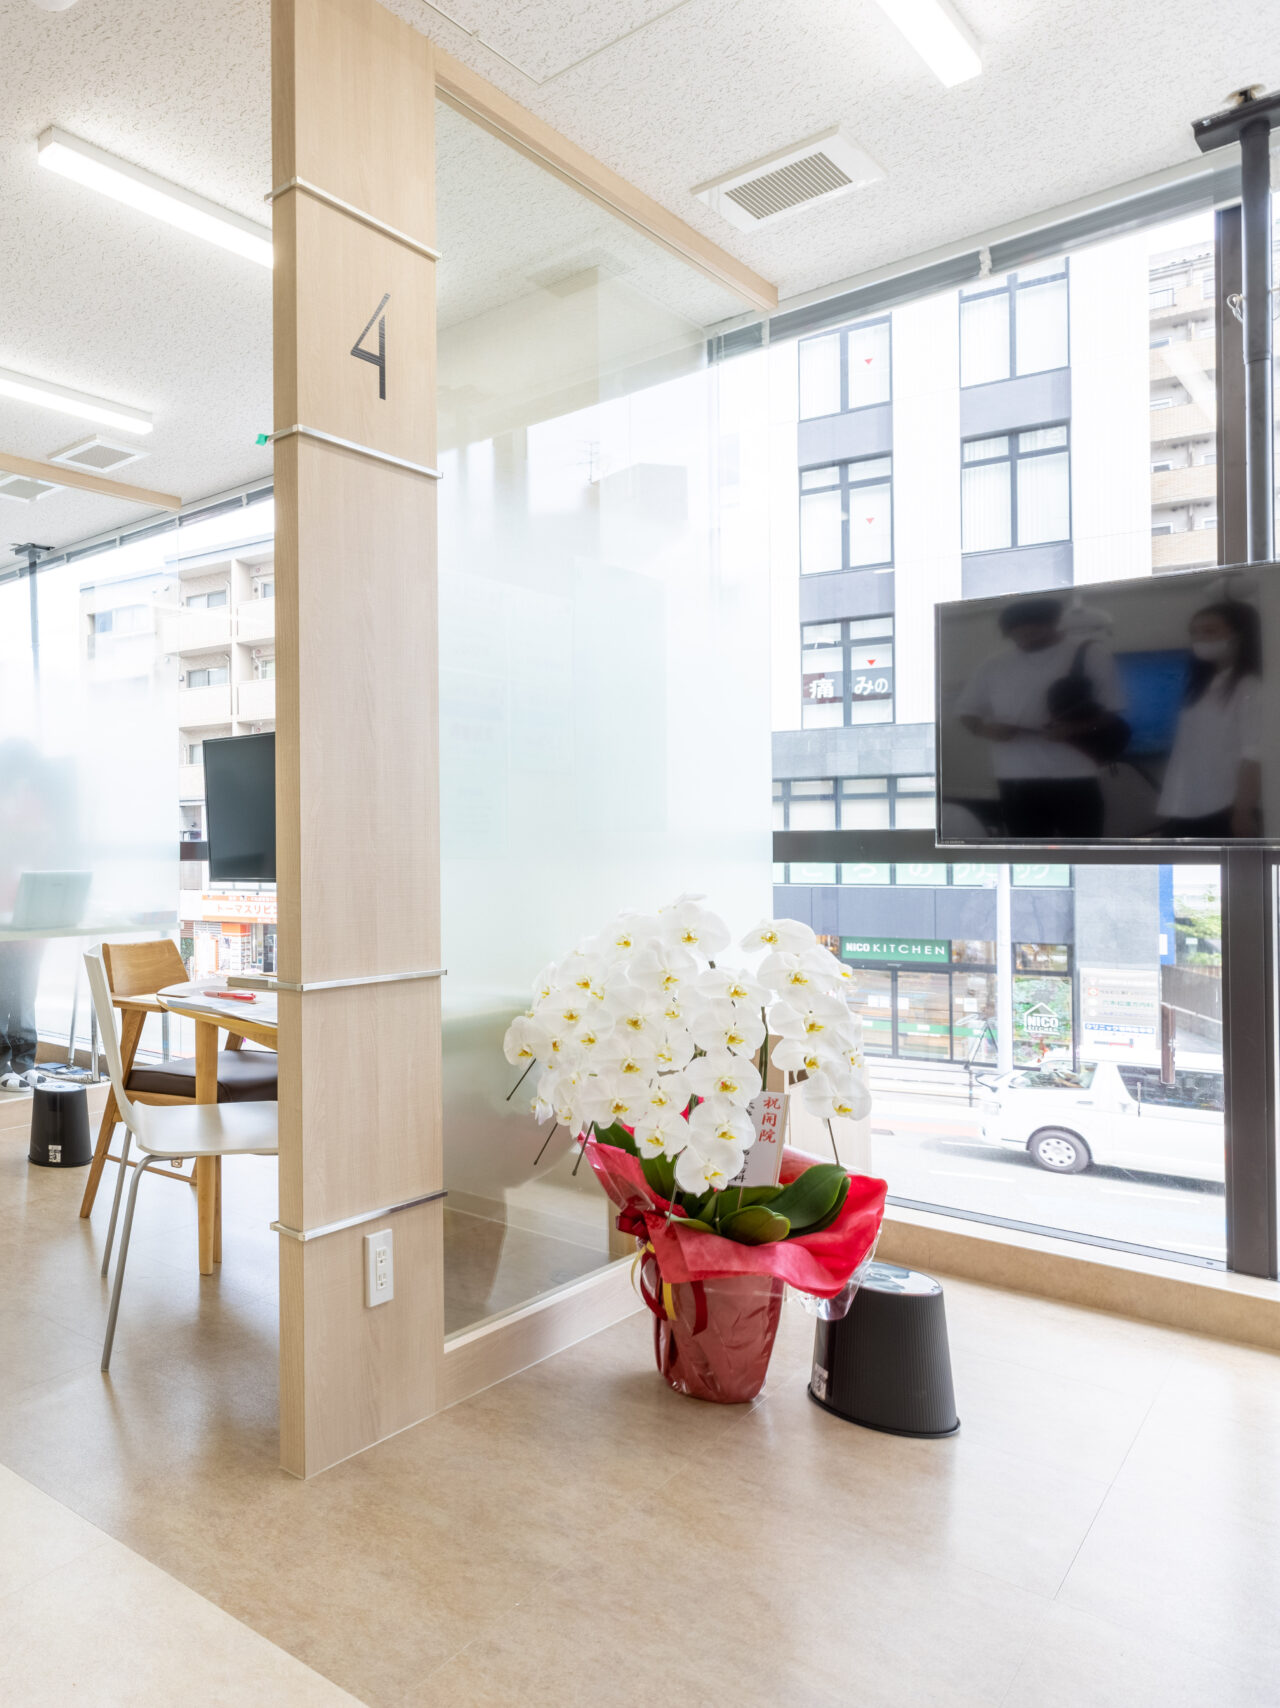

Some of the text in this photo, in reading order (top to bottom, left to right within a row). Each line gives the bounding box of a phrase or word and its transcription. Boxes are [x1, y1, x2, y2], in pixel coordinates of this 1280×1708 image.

[350, 292, 391, 400] 4
[845, 942, 946, 956] NICO KITCHEN
[1027, 1015, 1059, 1028] NICO
[758, 1096, 781, 1144] 祝開院
